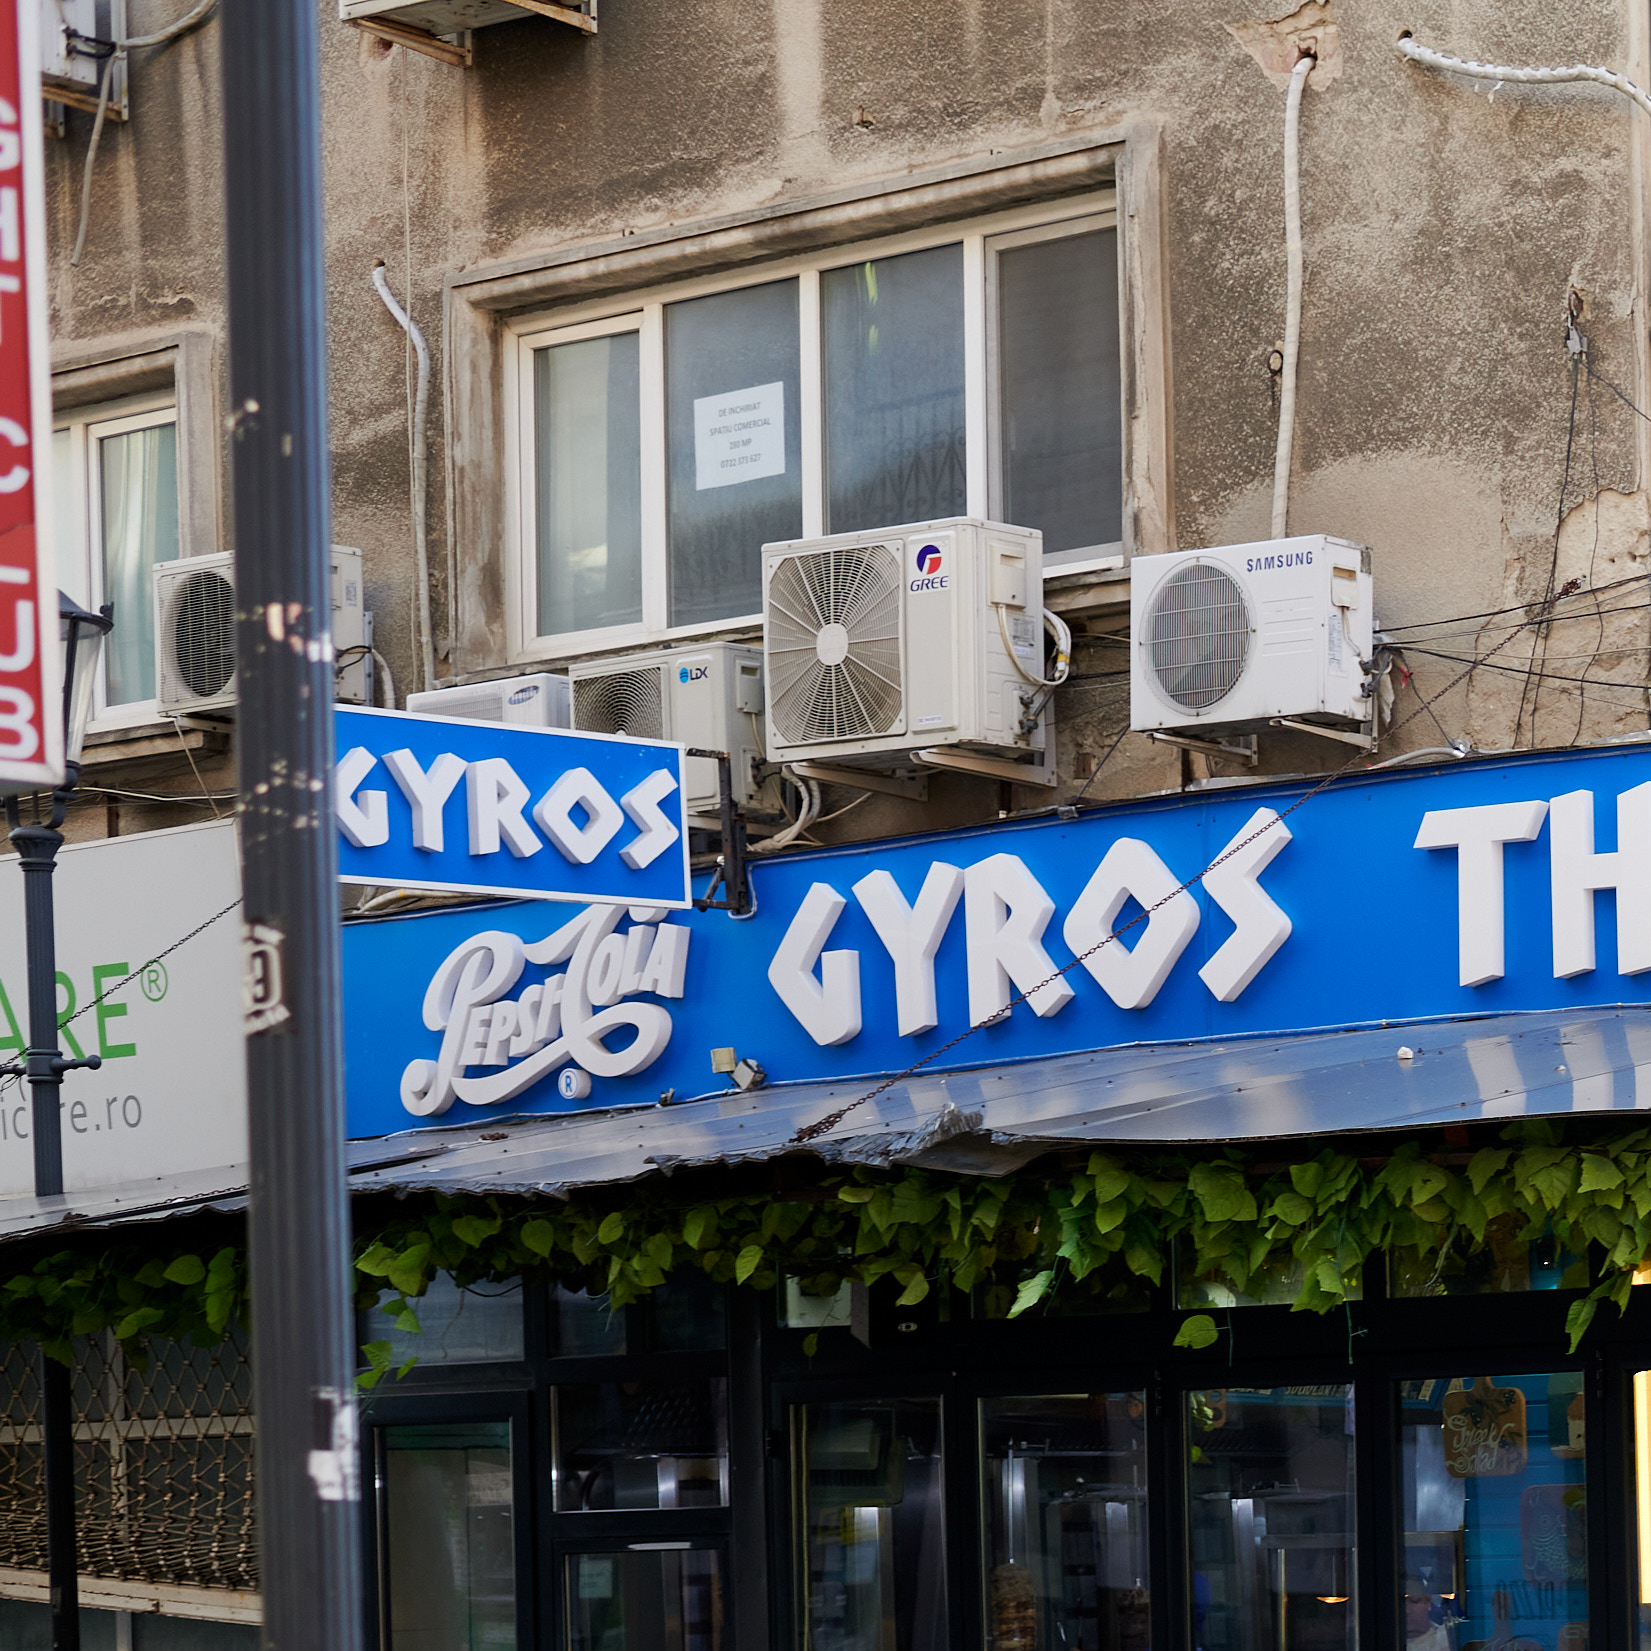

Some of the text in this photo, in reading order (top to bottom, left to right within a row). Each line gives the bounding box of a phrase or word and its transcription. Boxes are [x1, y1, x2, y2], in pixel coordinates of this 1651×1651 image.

[910, 576, 949, 592] GREE
[1247, 551, 1313, 573] SAMSUNG
[337, 746, 679, 870] GYROS
[767, 806, 1293, 1047] GYROS
